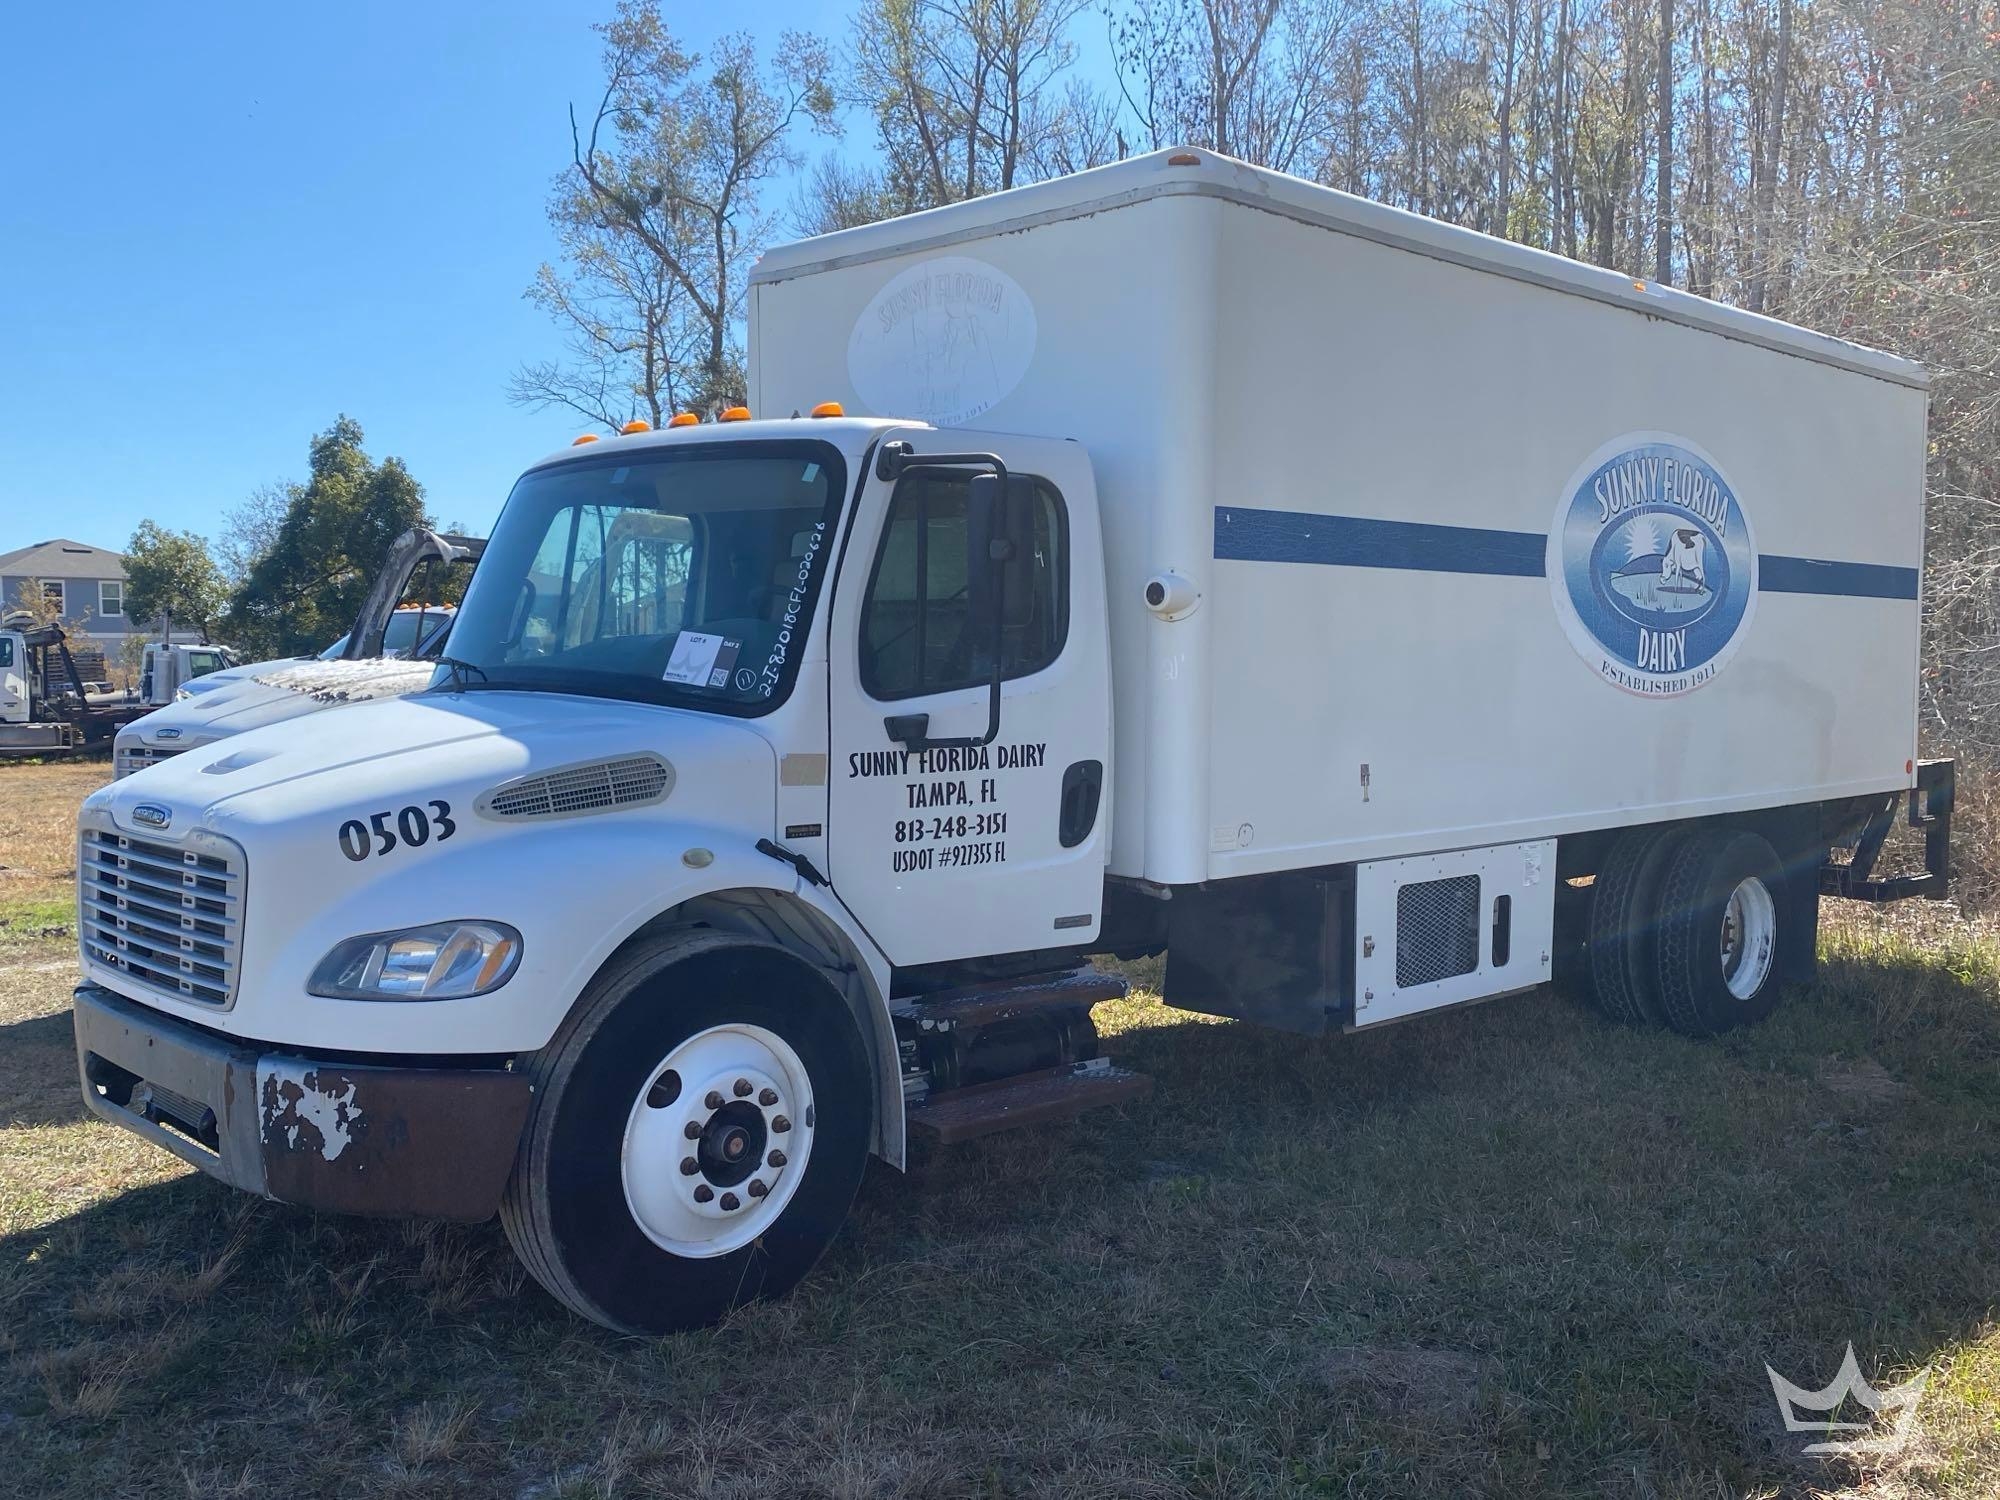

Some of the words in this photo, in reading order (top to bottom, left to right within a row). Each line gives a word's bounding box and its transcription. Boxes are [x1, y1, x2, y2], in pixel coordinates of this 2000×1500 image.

[1594, 457, 1659, 524] SUNNY
[1663, 457, 1729, 537] FLORIDA
[1637, 627, 1687, 672] DAIRY
[1601, 660, 1687, 693] ESTABLISHED
[1690, 663, 1716, 687] 1911
[849, 750, 910, 778] SUNNY
[919, 746, 989, 774] FLORIDA
[997, 743, 1047, 769] DAIRY
[906, 781, 974, 808] TAMPA,
[981, 778, 997, 803] FL
[338, 800, 456, 862] 0503
[894, 812, 1007, 843] 813-248-3151
[893, 848, 934, 873] USDOT
[938, 842, 992, 867] #927355
[995, 841, 1006, 863] FL
